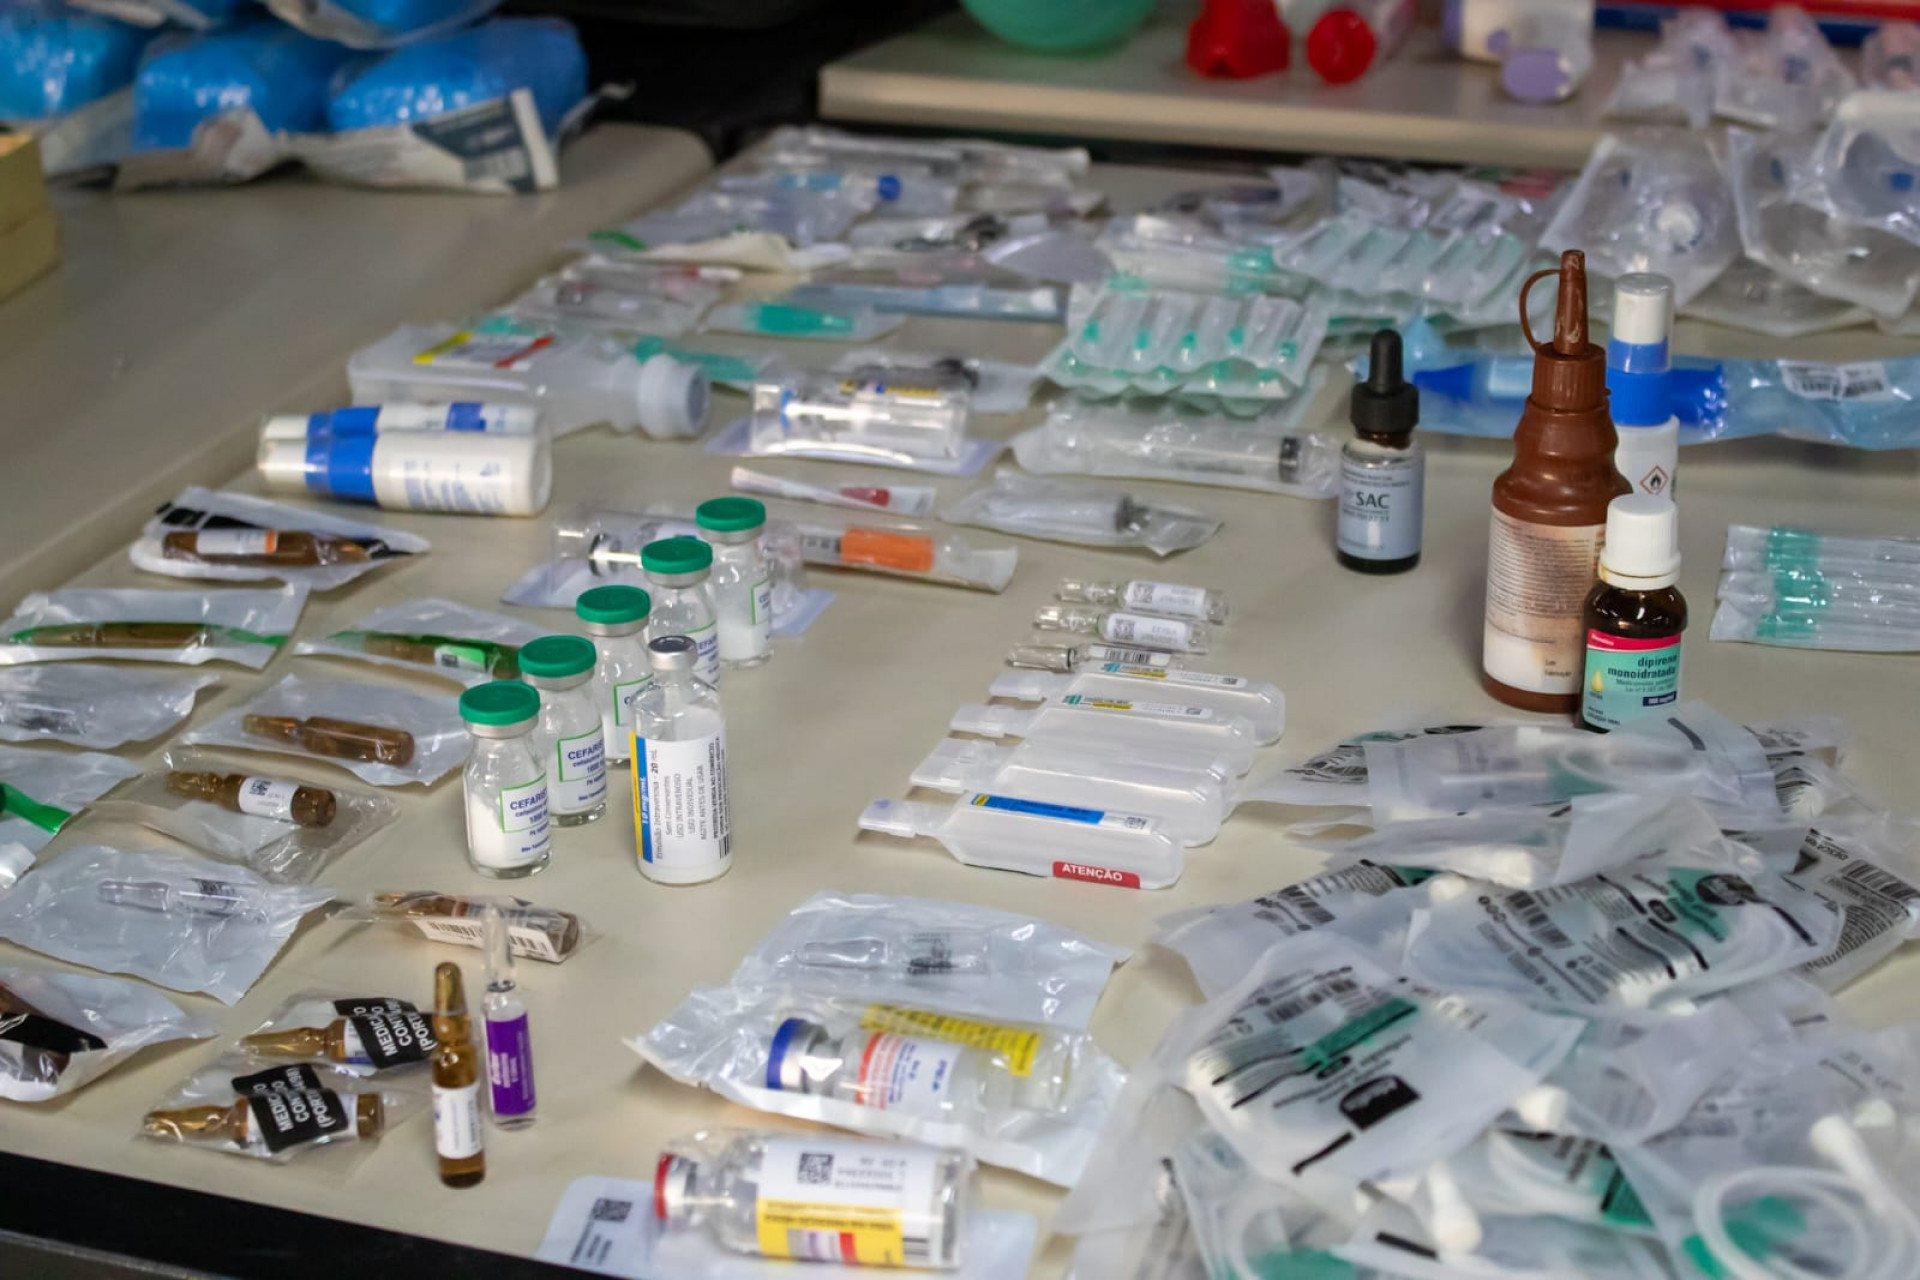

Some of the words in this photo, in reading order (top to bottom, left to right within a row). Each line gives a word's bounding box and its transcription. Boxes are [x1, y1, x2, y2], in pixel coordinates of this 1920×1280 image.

[1355, 491, 1390, 509] SAC
[650, 762, 659, 774] 20
[651, 782, 662, 826] Intravenosa
[674, 773, 684, 822] INTRAVENOSO
[676, 823, 685, 838] USO
[1061, 864, 1123, 882] ATENÇÃO
